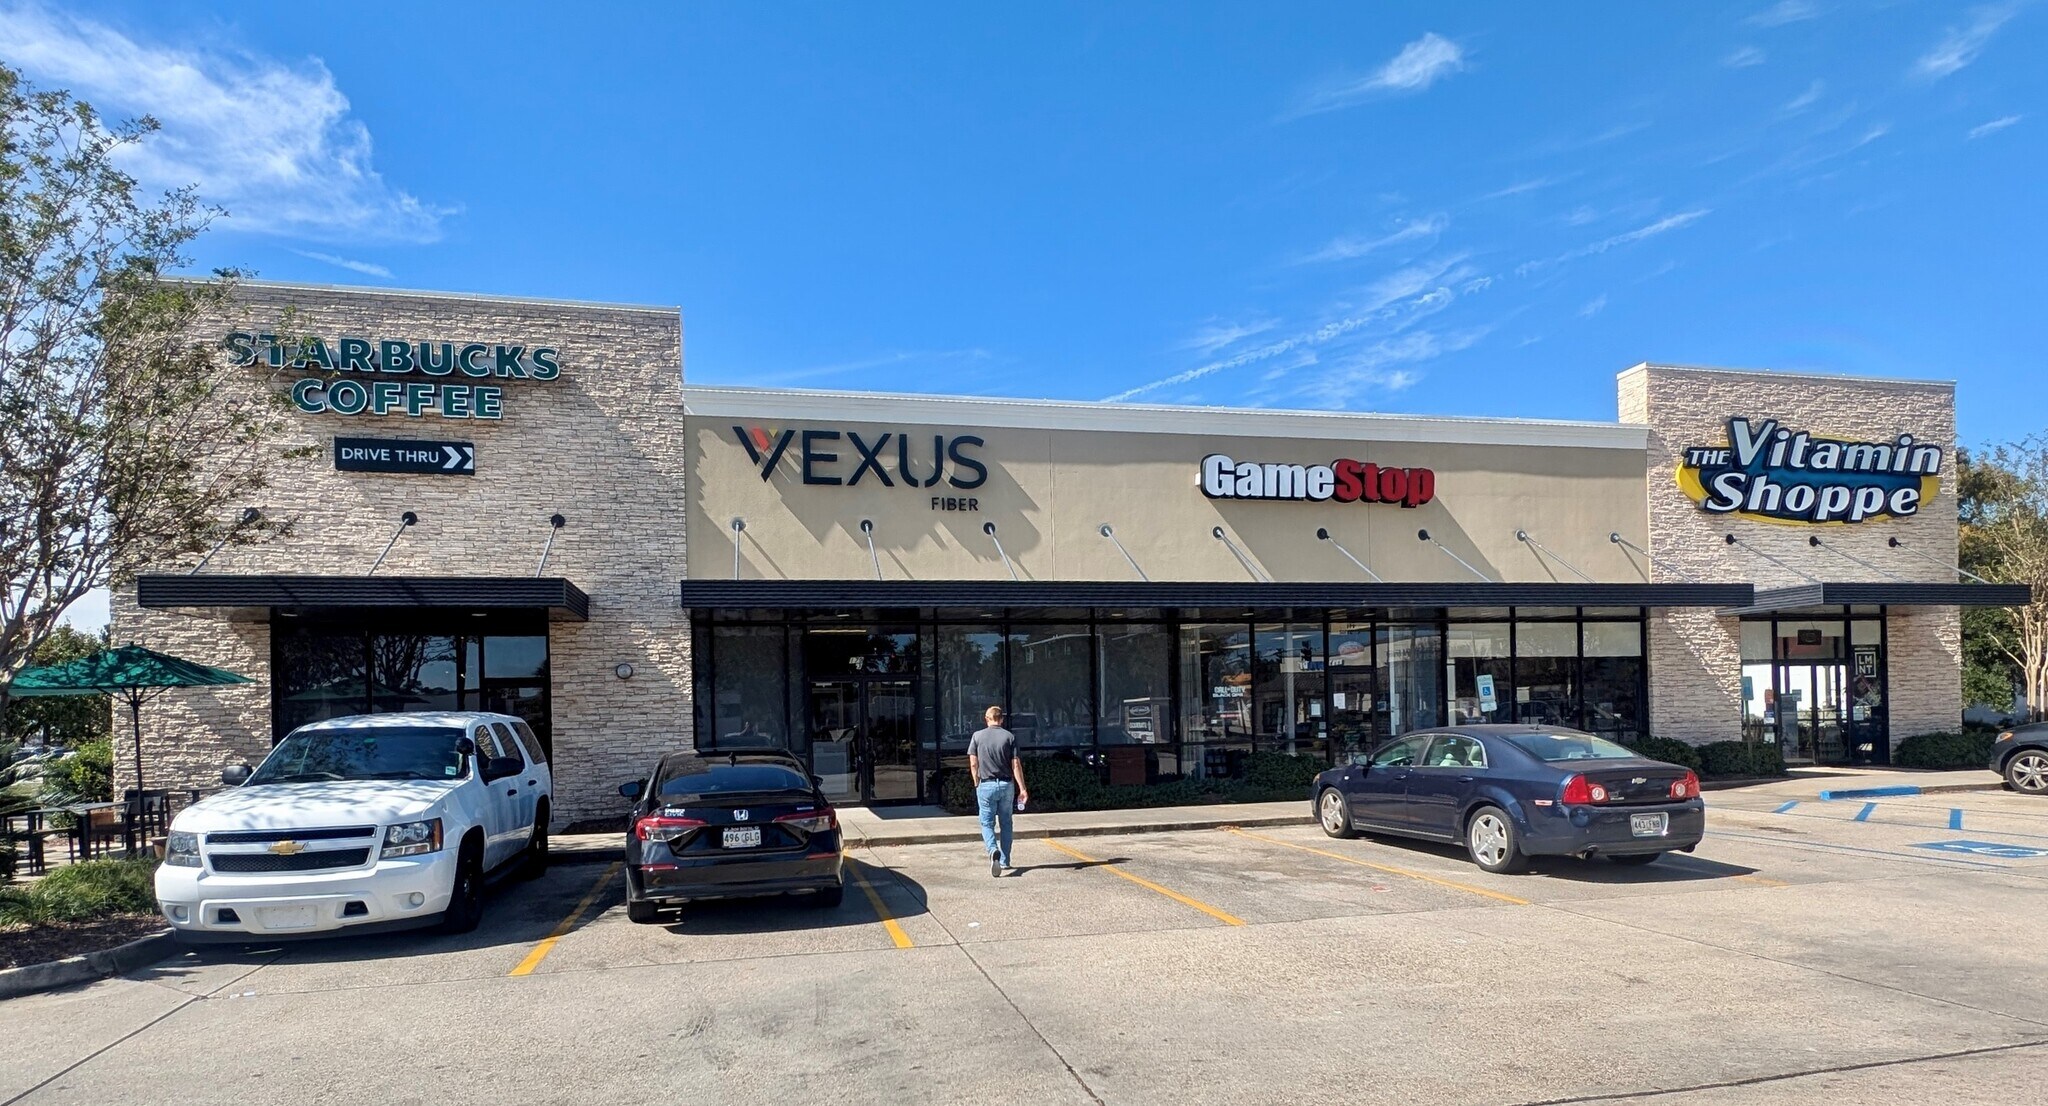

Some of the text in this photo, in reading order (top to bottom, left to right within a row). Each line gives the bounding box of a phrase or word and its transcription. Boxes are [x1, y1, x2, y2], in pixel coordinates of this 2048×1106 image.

[223, 332, 561, 381] STARBUCKS
[291, 378, 503, 420] COFFEE
[341, 448, 440, 464] DRIVE THRU
[732, 426, 988, 489] VEXUS
[1689, 418, 1943, 474] THE Vitamin
[931, 497, 979, 511] FIBER
[1201, 454, 1435, 507] GameStop
[1706, 472, 1920, 521] Shoppe
[724, 833, 740, 843] 496
